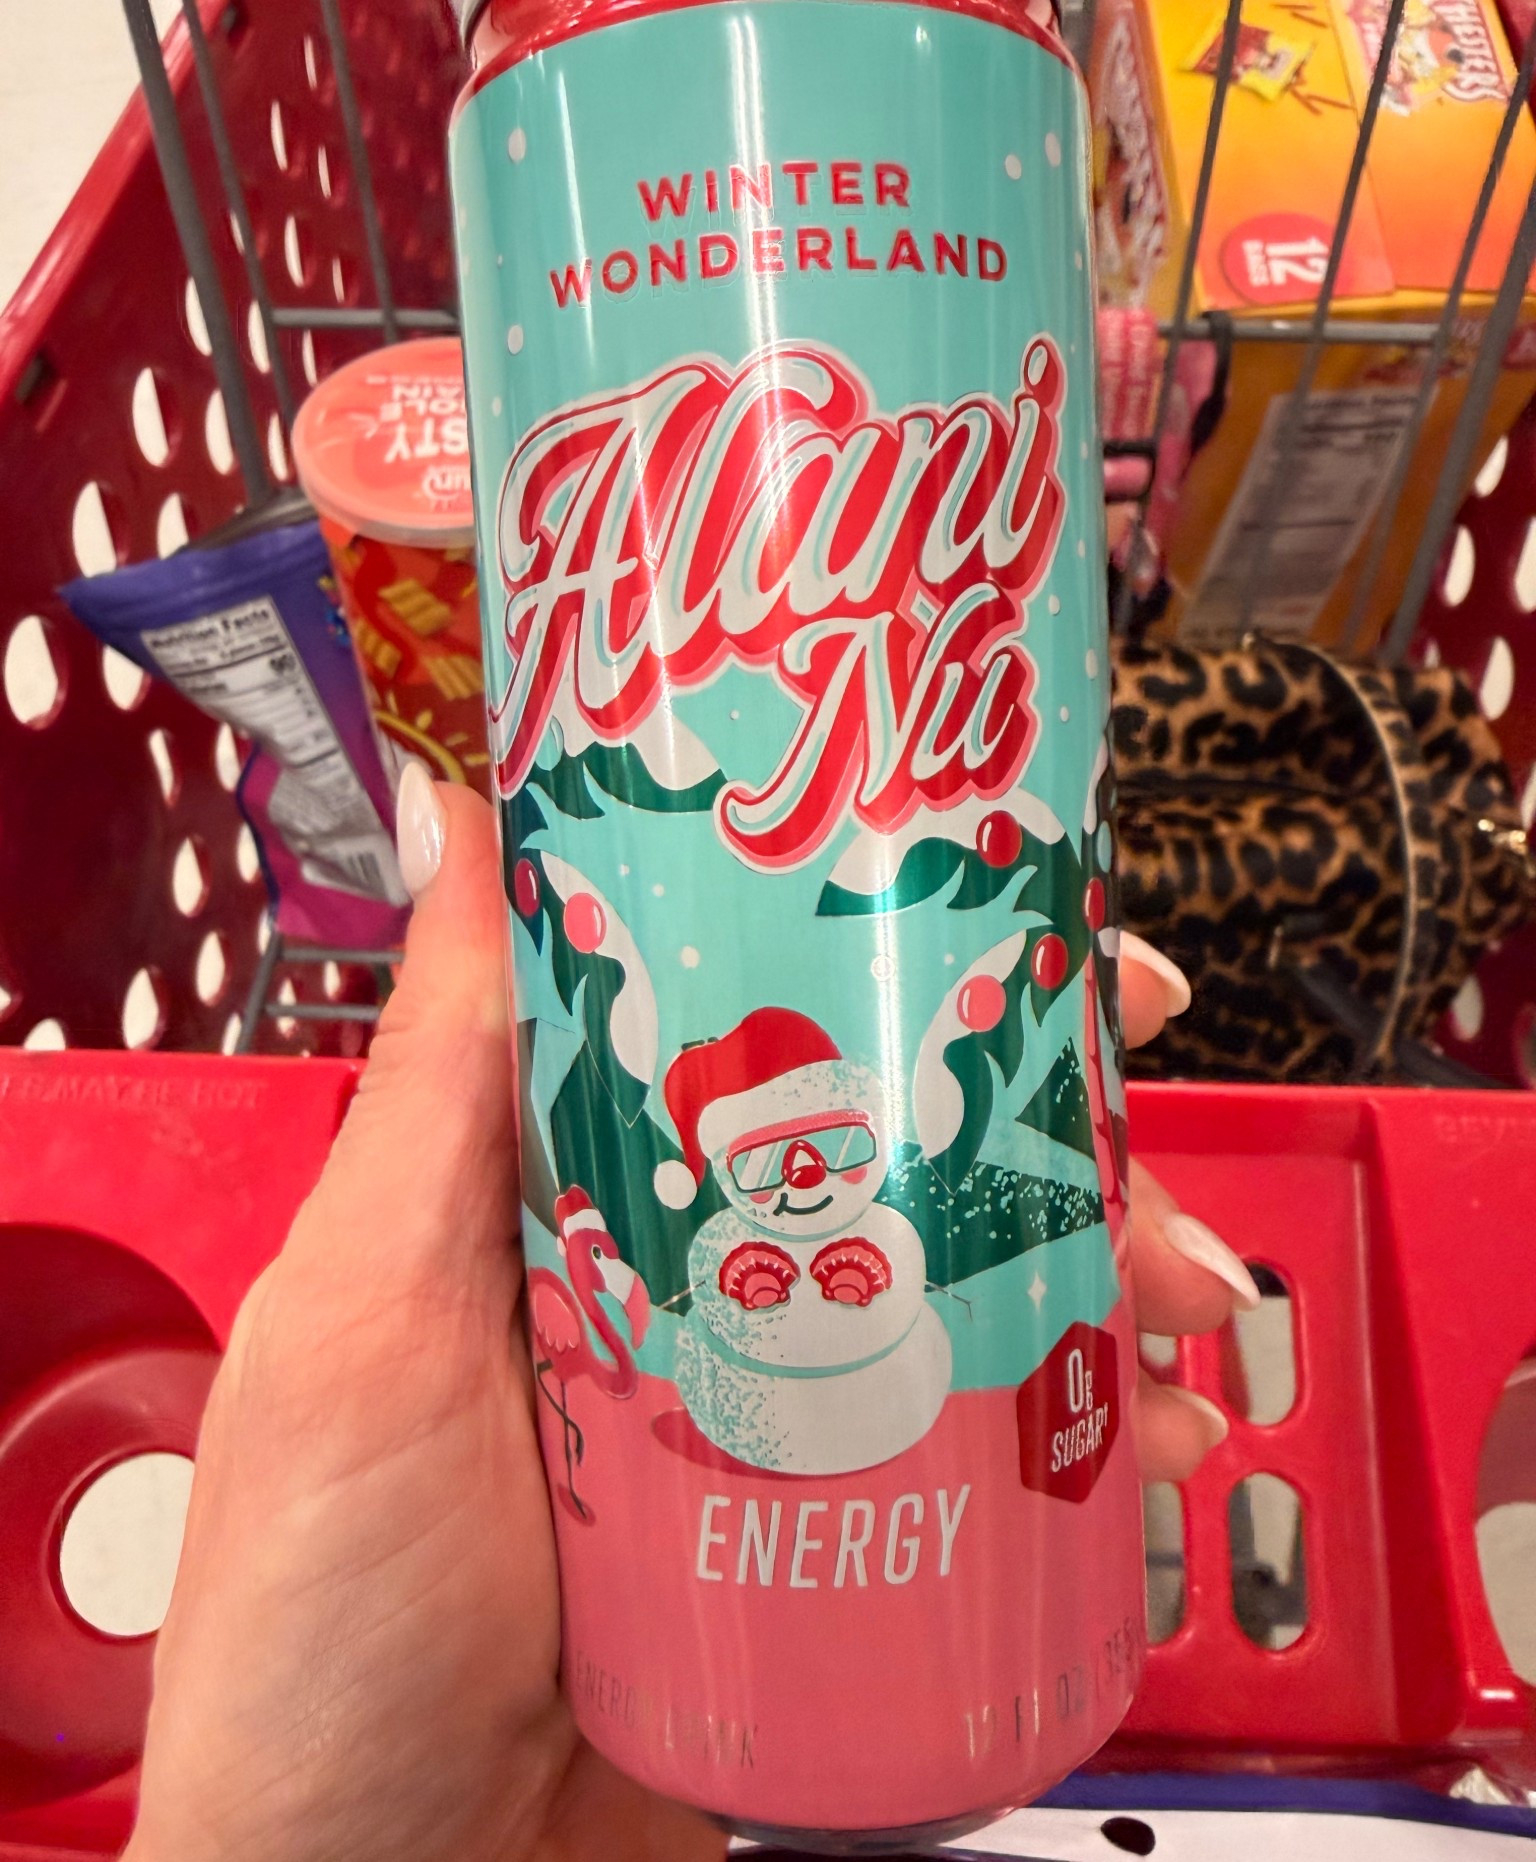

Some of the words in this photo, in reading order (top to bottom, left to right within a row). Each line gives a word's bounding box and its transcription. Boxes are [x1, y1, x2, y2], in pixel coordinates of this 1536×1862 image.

[637, 160, 911, 222] WINTER
[549, 226, 1008, 310] WONDERLAND
[1265, 235, 1330, 285] 12
[383, 416, 469, 464] STY
[488, 338, 1066, 800] Alani
[713, 577, 1042, 876] Nu
[697, 1484, 971, 1589] ENERGY
